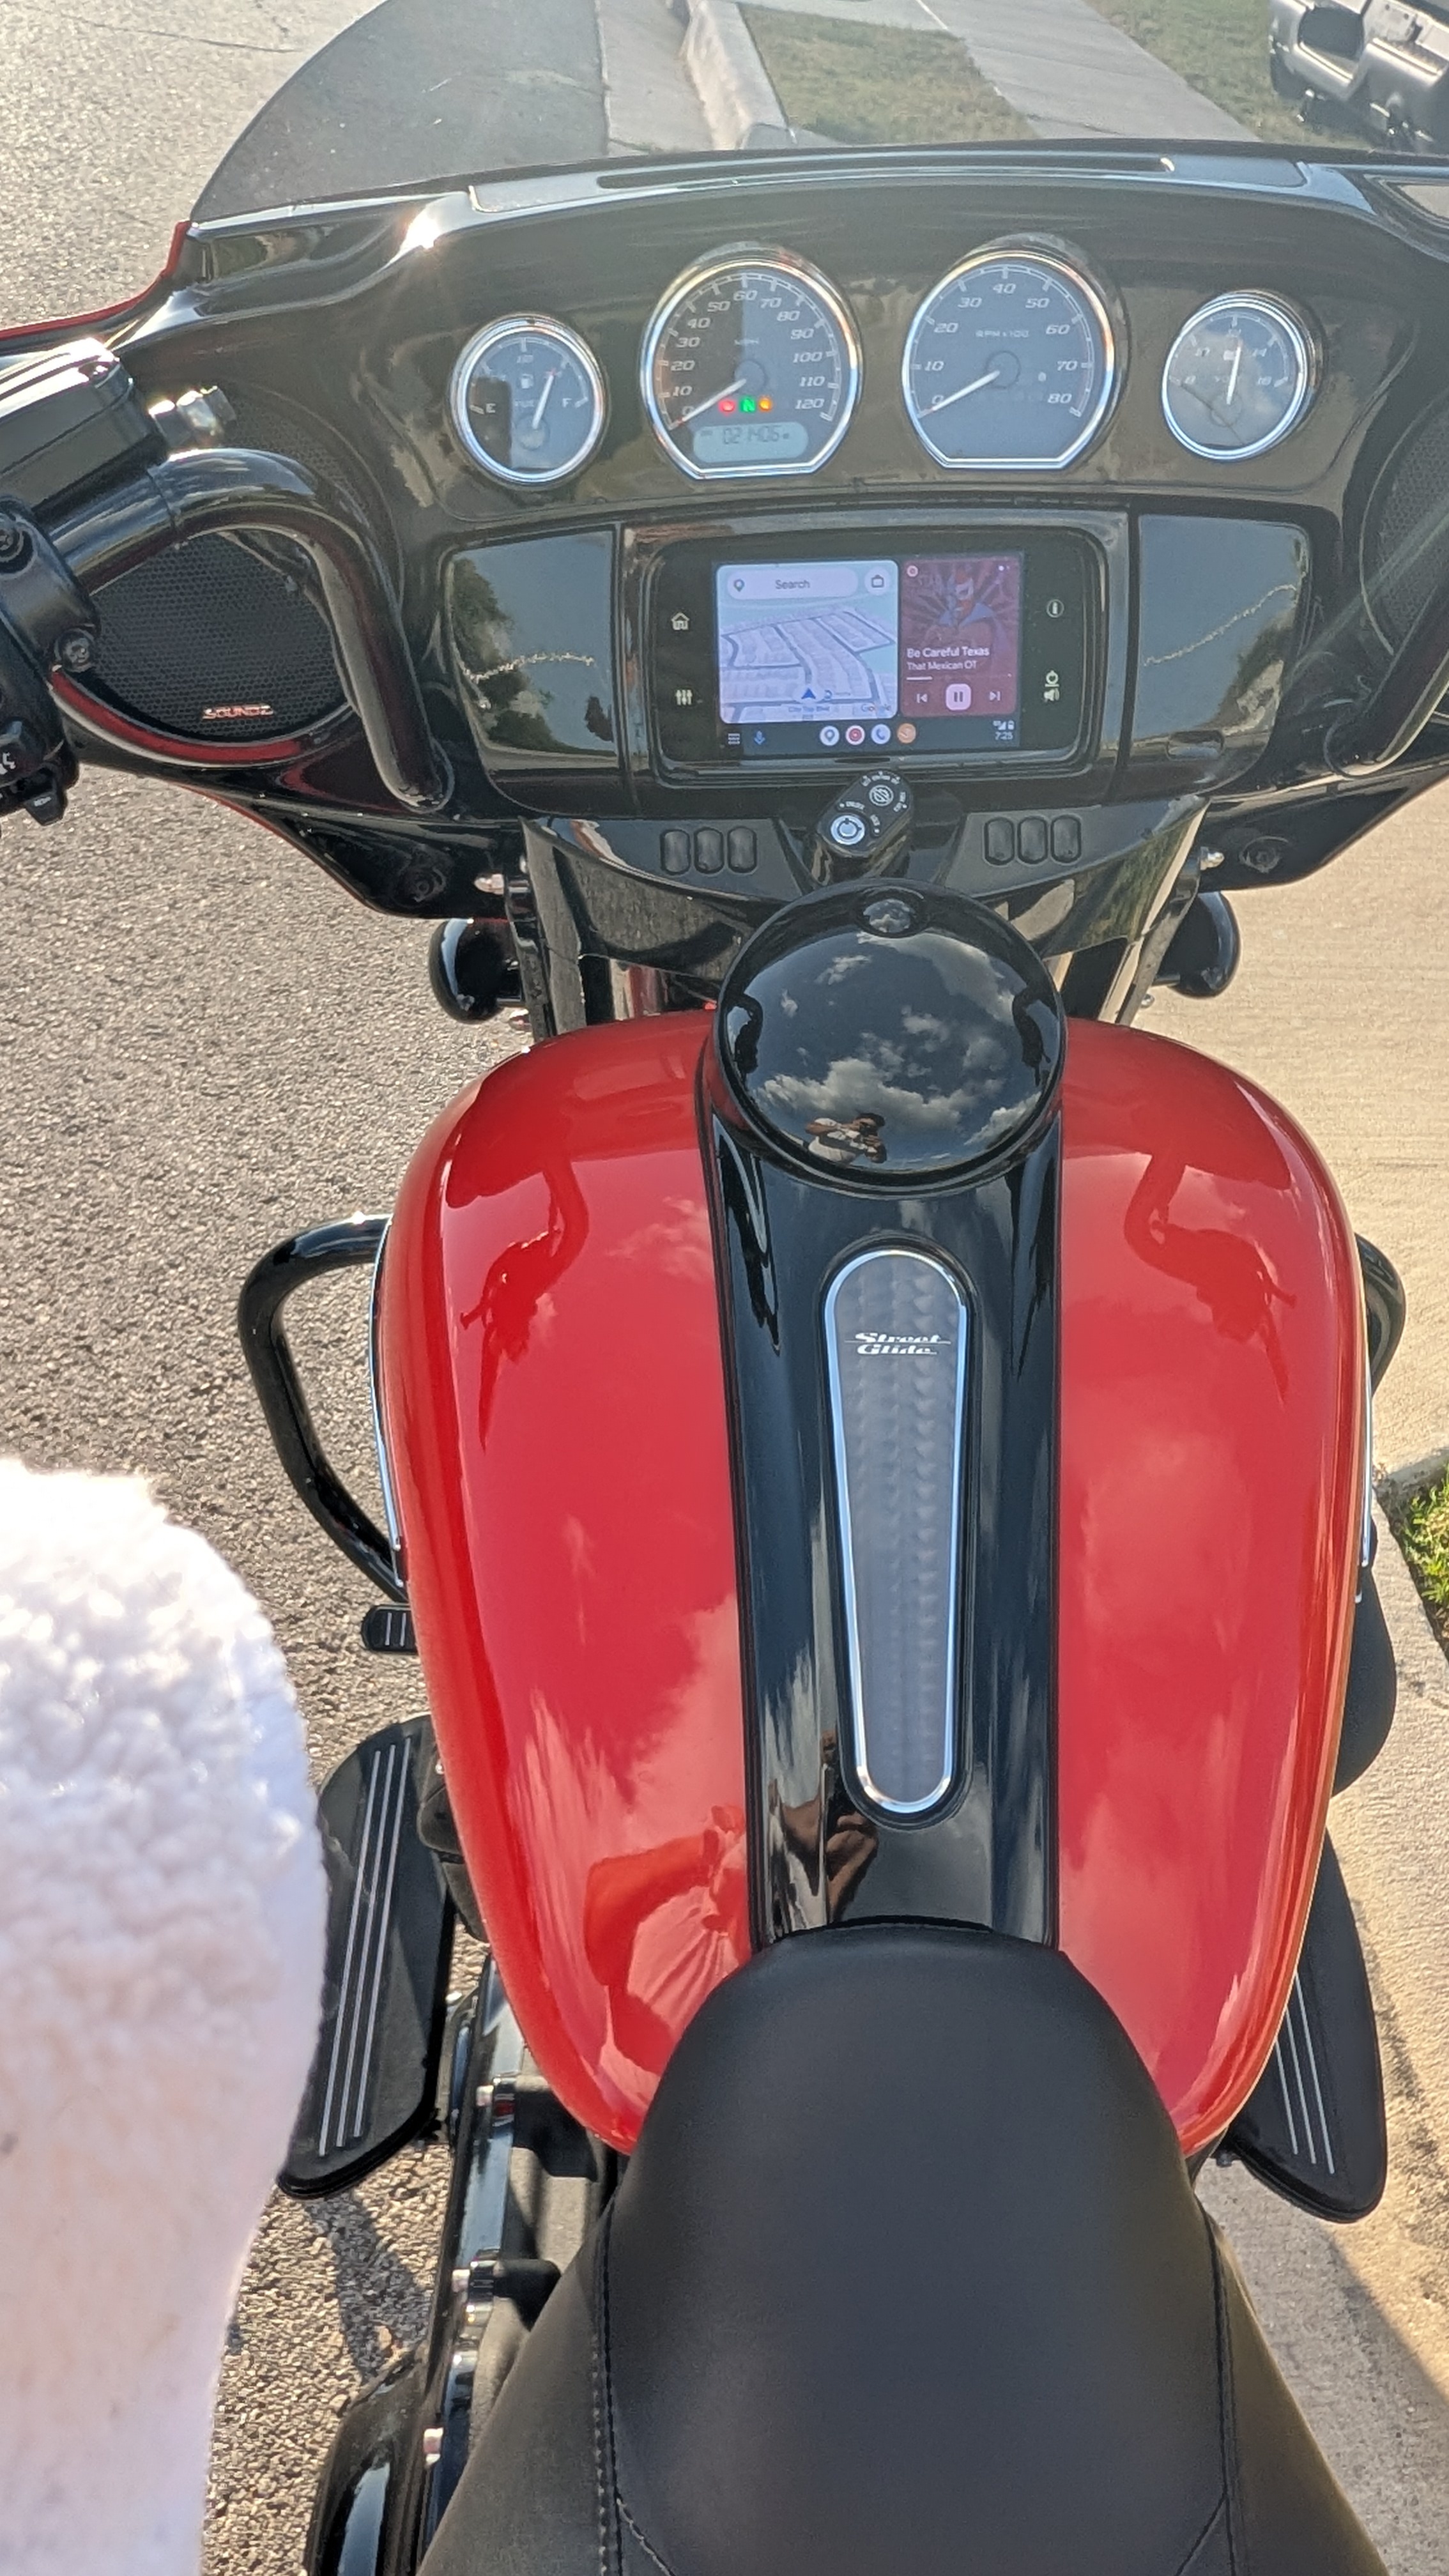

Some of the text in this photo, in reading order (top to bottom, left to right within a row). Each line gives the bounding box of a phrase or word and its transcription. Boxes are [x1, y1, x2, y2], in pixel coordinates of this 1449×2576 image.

[993, 284, 1016, 293] 40
[733, 291, 758, 301] 60
[707, 301, 731, 312] 50
[760, 298, 782, 309] 70
[958, 298, 982, 308] 30
[1025, 298, 1050, 309] 50
[777, 310, 800, 321] 80
[687, 318, 711, 328] 40
[934, 323, 958, 333] 20
[790, 328, 815, 340] 90
[1046, 325, 1070, 335] 60
[677, 337, 701, 348] 30
[793, 352, 823, 363] 100
[671, 360, 695, 371] 20
[924, 360, 944, 371] 10
[1057, 360, 1078, 371] 70
[799, 376, 825, 387] 110
[672, 387, 693, 397] 10
[563, 398, 572, 408] F
[1047, 393, 1072, 404] 80
[486, 403, 496, 413] E
[795, 399, 824, 410] 120
[775, 579, 810, 590] Search
[907, 647, 990, 658] Be Careful Texas
[907, 661, 977, 670] That Mexican OT
[855, 1332, 942, 1344] Street
[857, 1344, 937, 1355] Glide
